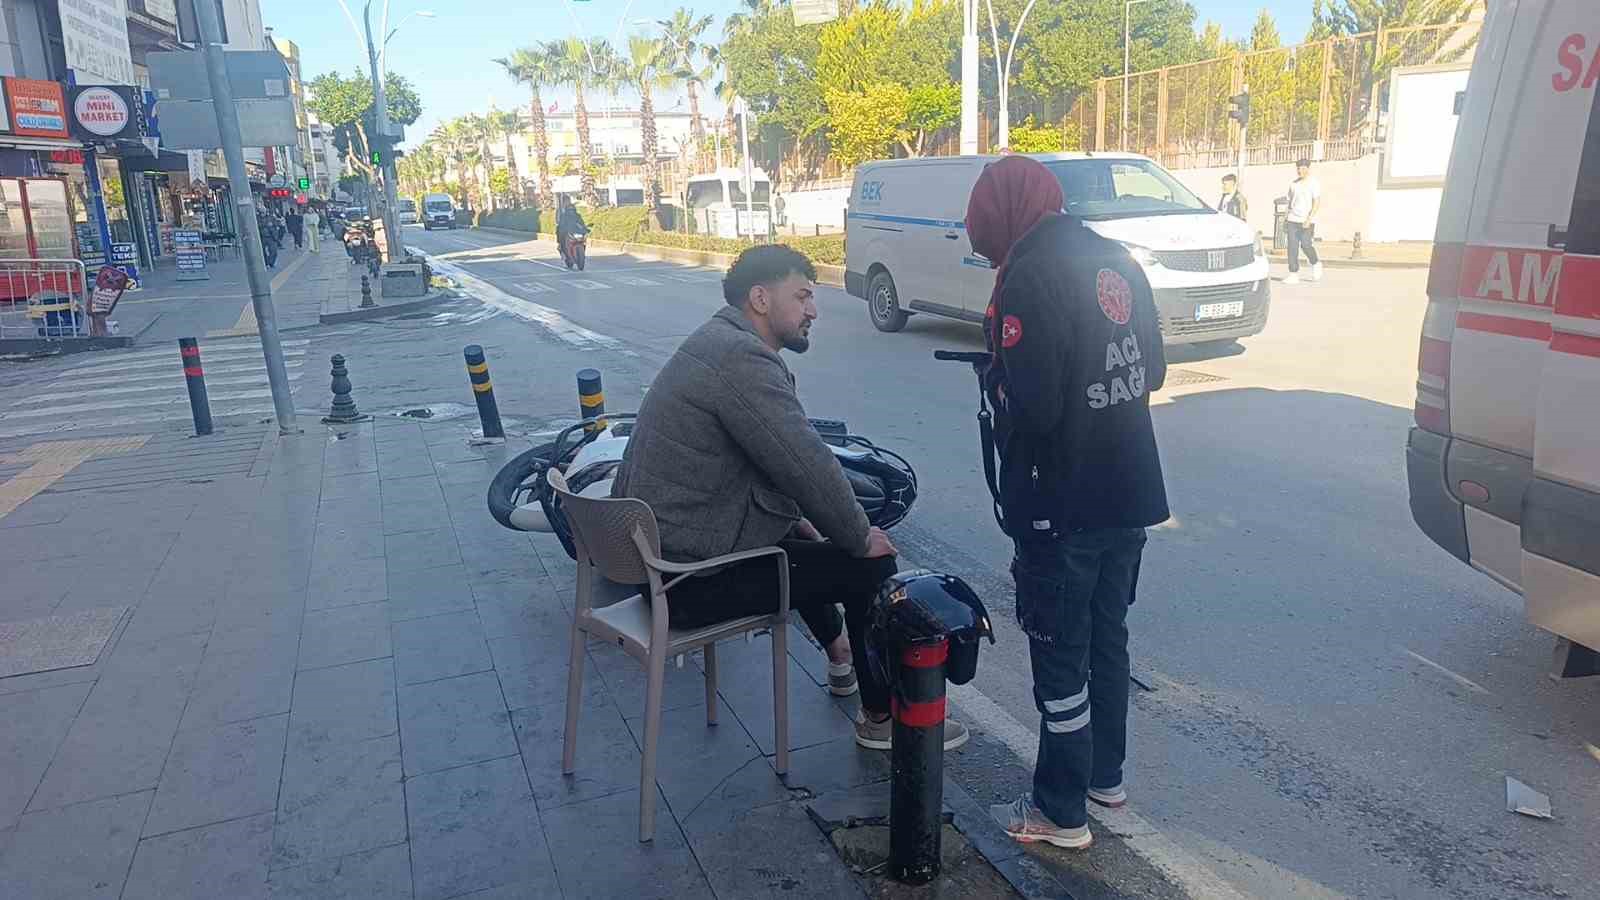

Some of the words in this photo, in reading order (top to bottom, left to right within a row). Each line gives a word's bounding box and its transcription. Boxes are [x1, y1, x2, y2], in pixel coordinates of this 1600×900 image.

[87, 101, 115, 110] MINI
[80, 112, 124, 121] MARKET
[861, 181, 885, 200] BEK
